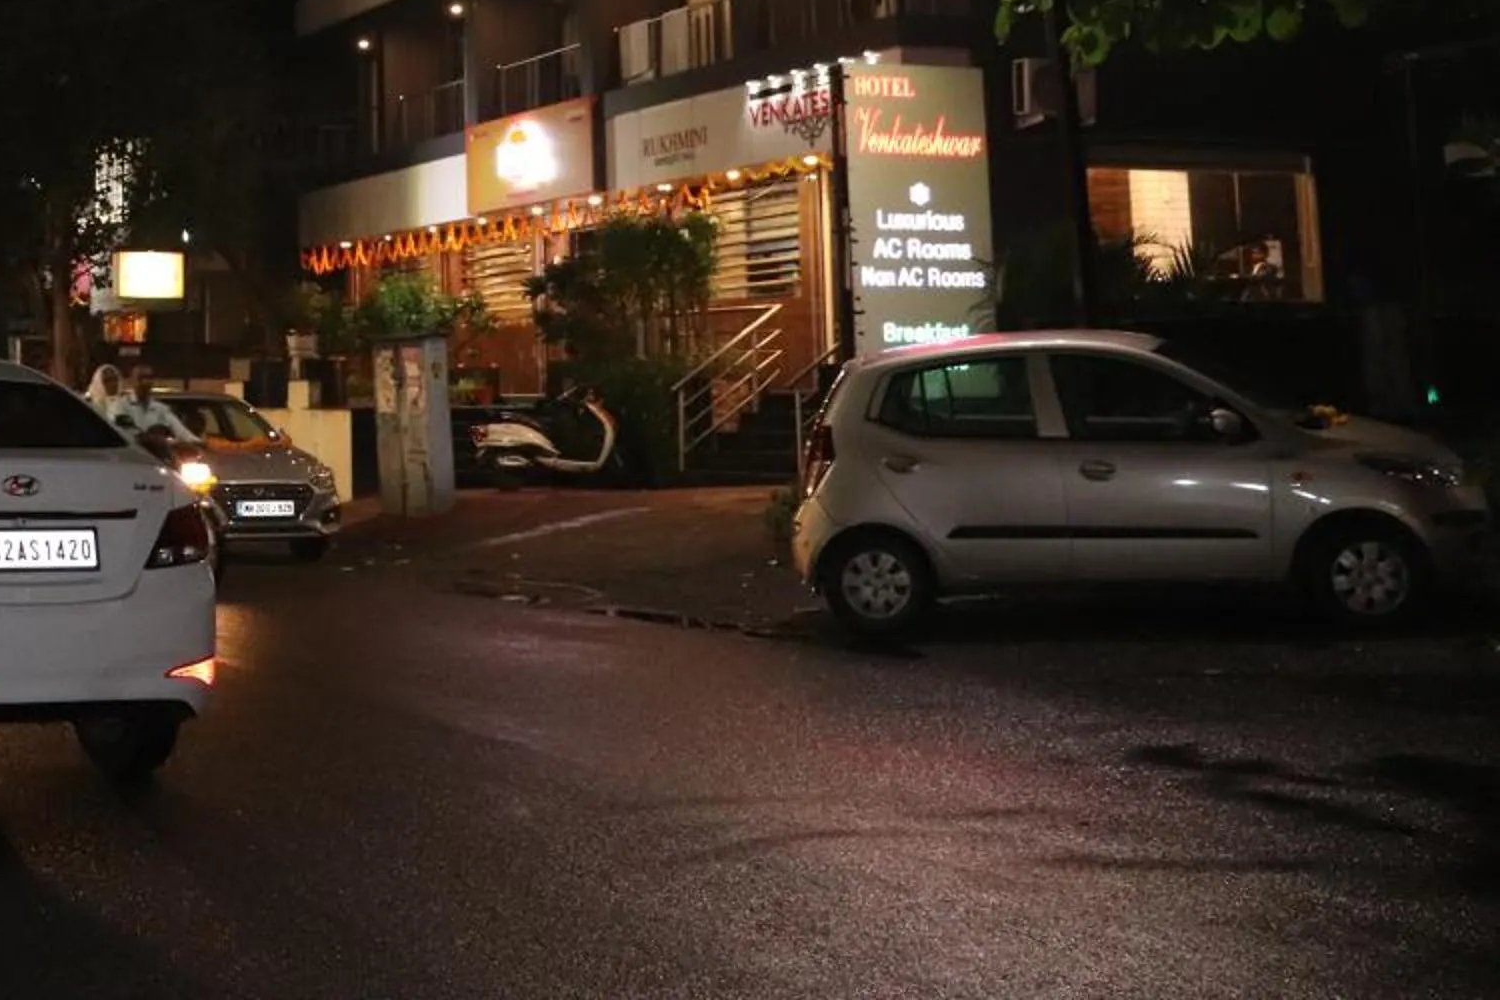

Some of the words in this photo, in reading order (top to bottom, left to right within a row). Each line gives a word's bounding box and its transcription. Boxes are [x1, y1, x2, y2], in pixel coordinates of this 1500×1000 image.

[854, 74, 916, 98] HOTEL
[853, 105, 984, 158] Venkateshwar
[876, 209, 965, 231] Luxurious
[873, 238, 902, 260] AC
[906, 238, 973, 261] Rooms
[861, 266, 896, 287] Non
[897, 267, 924, 287] AC
[928, 268, 986, 288] Rooms
[883, 321, 970, 342] Breakfast
